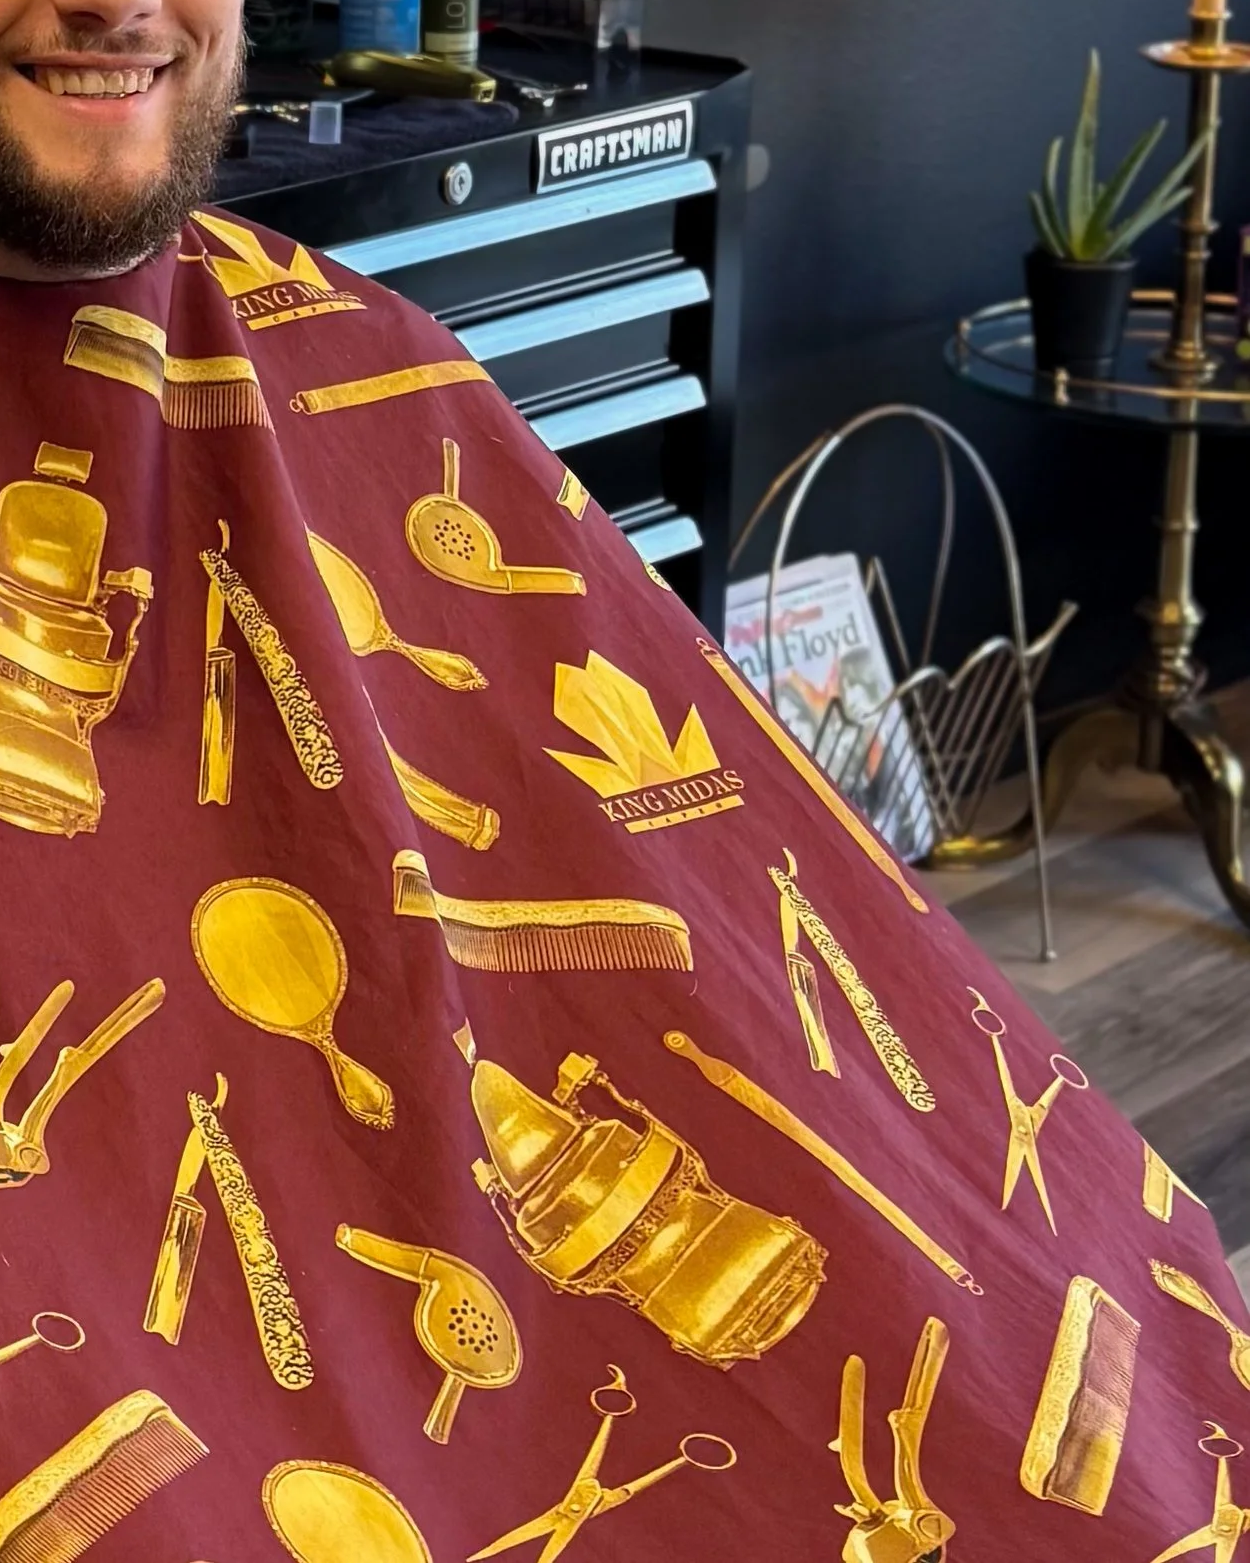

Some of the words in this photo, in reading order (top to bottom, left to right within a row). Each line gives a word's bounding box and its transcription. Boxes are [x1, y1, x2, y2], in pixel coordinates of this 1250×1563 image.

[550, 118, 683, 177] CRAFTSMAN
[232, 287, 294, 318] KING
[778, 612, 861, 666] Floyd
[598, 791, 664, 822] KING
[661, 770, 745, 808] MIDAS
